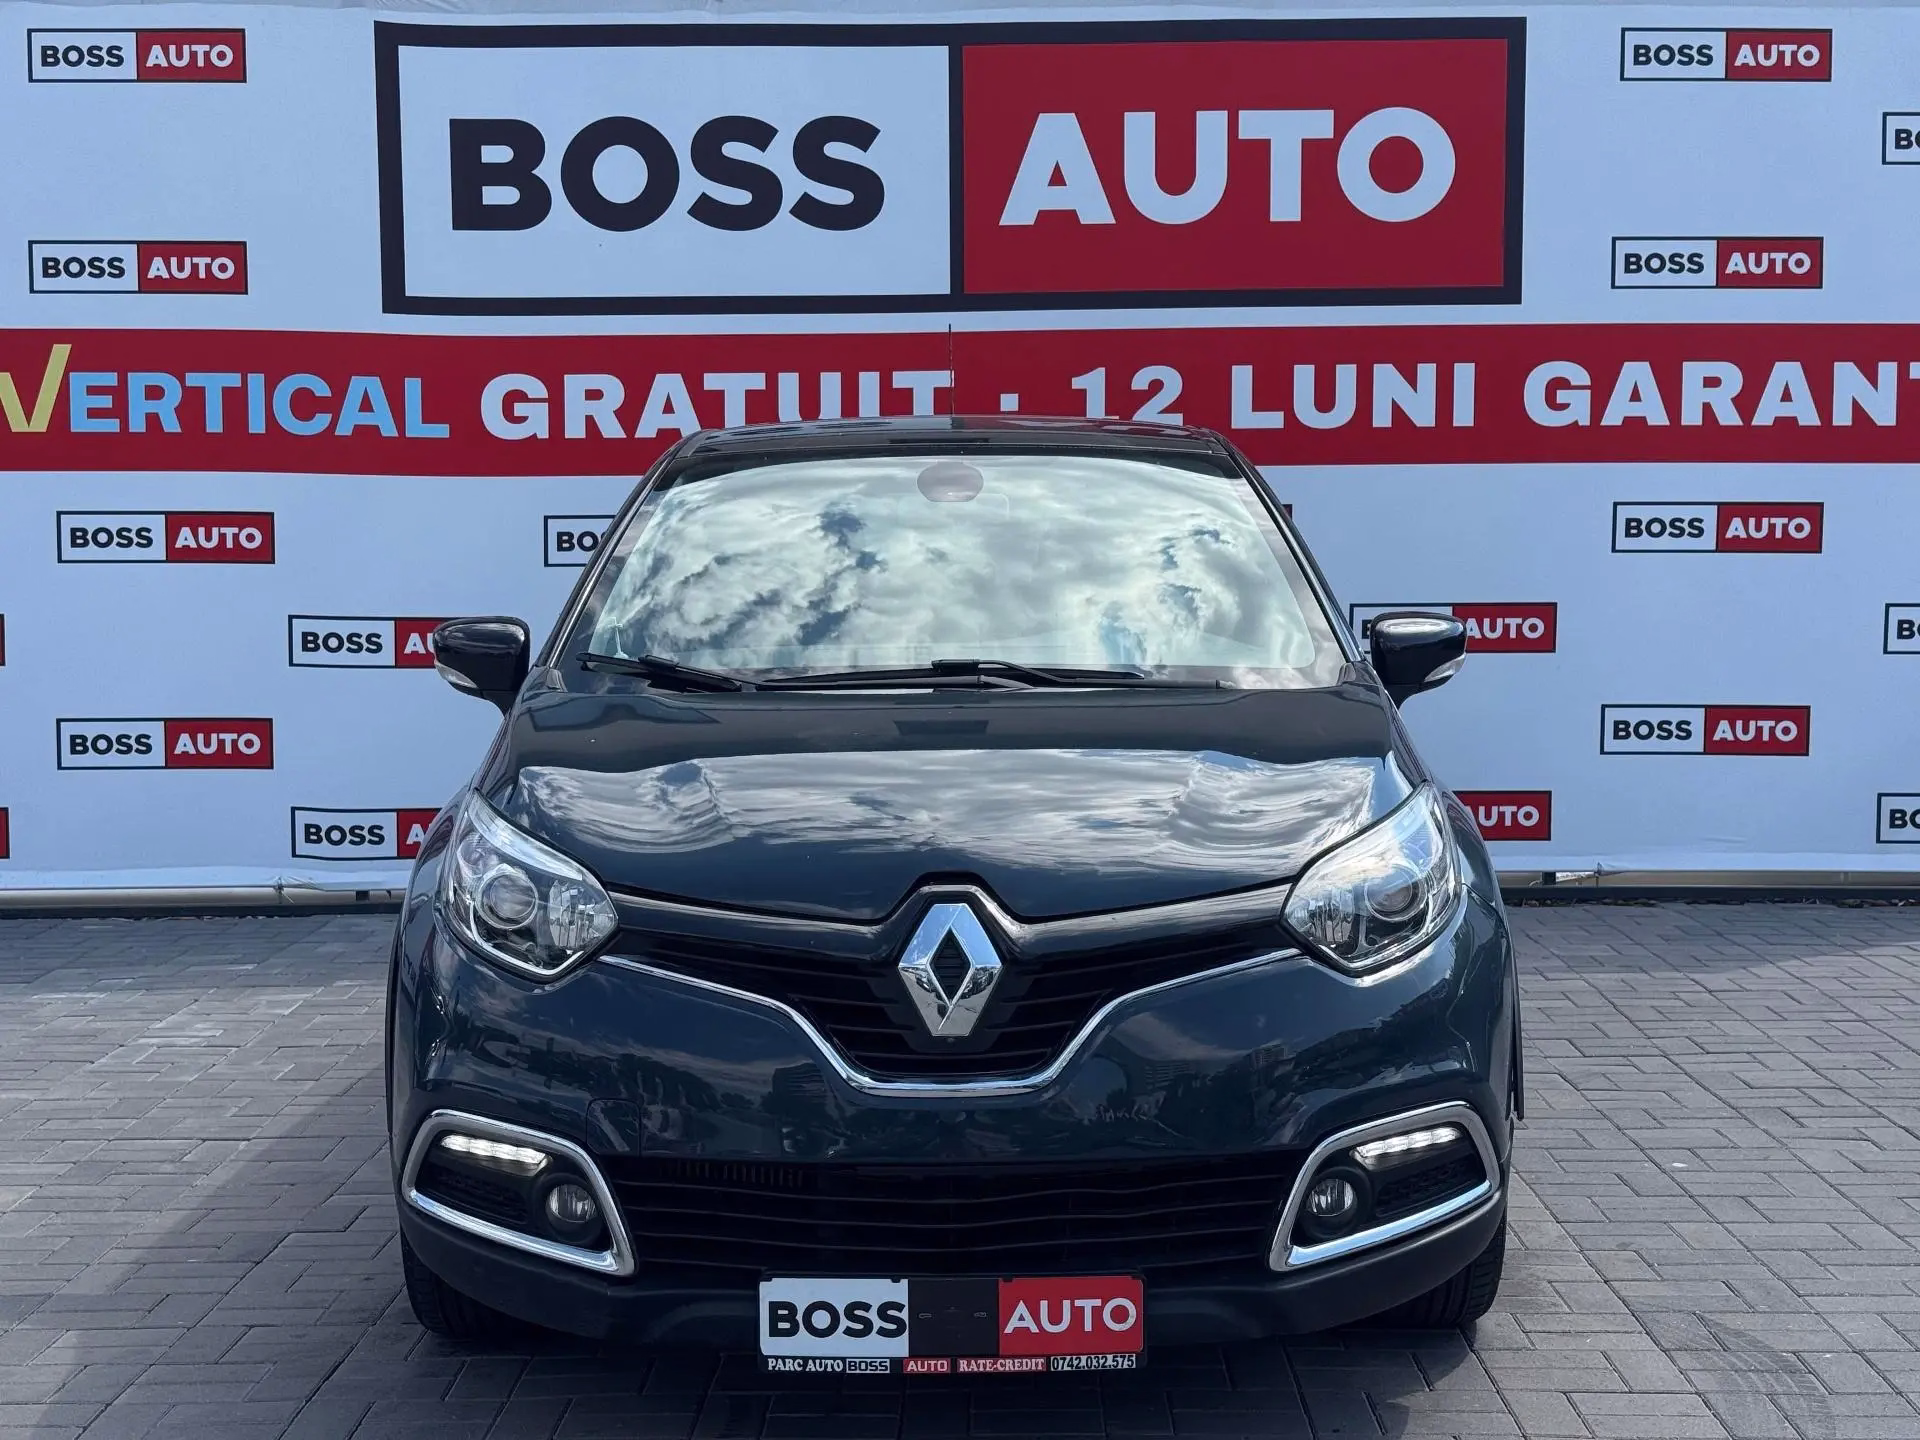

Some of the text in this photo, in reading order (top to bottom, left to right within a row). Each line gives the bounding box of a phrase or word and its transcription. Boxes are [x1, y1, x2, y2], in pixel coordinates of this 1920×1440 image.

[41, 45, 233, 68] BOSS AUTO
[1633, 44, 1820, 66] BOSS AUTO
[450, 107, 1455, 232] BOSS AUTO
[42, 257, 234, 279] BOSS AUTO
[1624, 252, 1811, 274] BOSS AUTO
[0, 344, 449, 438] VERTICAL
[481, 370, 954, 439] GRATUIT
[1071, 365, 1183, 426] 12
[1231, 363, 1475, 429] LUNI
[1524, 361, 1920, 427] GARAN
[70, 527, 262, 549] BOSS AUTO
[1624, 517, 1811, 539] BOSS AUTO
[556, 530, 606, 552] BO
[1466, 618, 1545, 639] AUTO
[301, 631, 383, 654] BOSS
[1613, 720, 1797, 741] BOSS AUTO
[70, 733, 261, 755] BOSS AUTO
[304, 823, 385, 846] BOSS
[769, 1298, 1136, 1338] BOSS AUTO
[768, 1358, 803, 1371] PARC
[805, 1359, 843, 1372] AUTO
[848, 1360, 888, 1372] BOSS
[907, 1360, 948, 1372] AUTO
[1052, 1355, 1134, 1370] 0742.032.575
